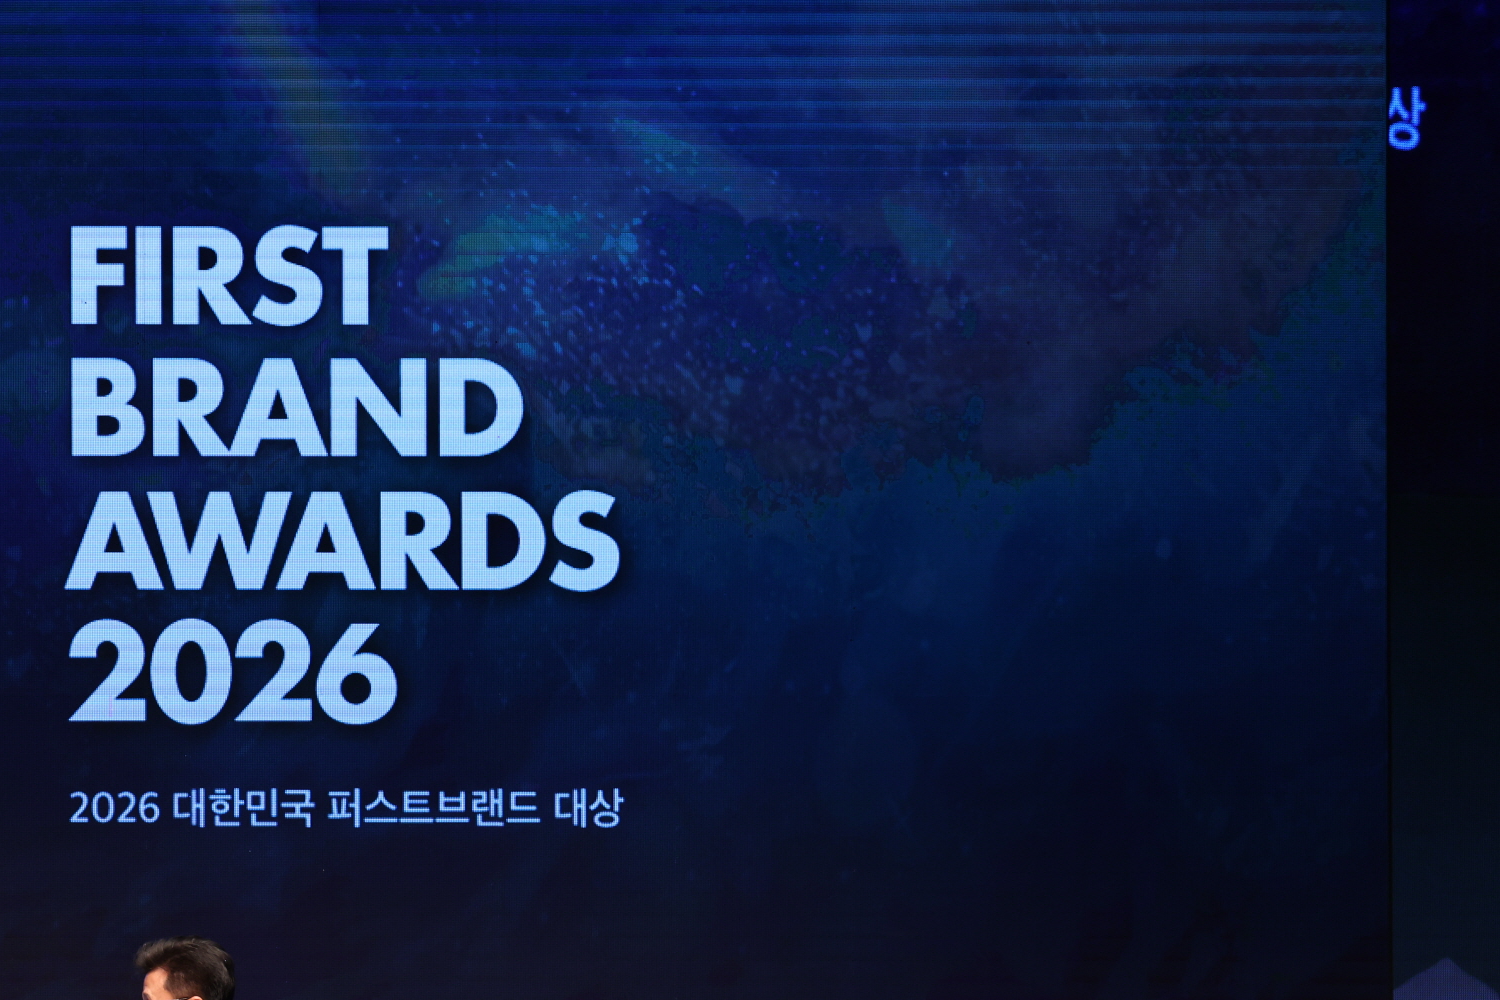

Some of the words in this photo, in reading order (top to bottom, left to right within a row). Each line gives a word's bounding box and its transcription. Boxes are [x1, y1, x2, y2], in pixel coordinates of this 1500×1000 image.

[71, 224, 389, 326] FIRST
[71, 357, 524, 457] BRAND
[65, 489, 620, 592] AWARDS
[69, 618, 398, 725] 2026
[70, 790, 160, 824] 2026
[173, 788, 316, 828] 대한민국
[328, 788, 541, 828] 퍼스트브랜드
[554, 788, 625, 828] 대상
